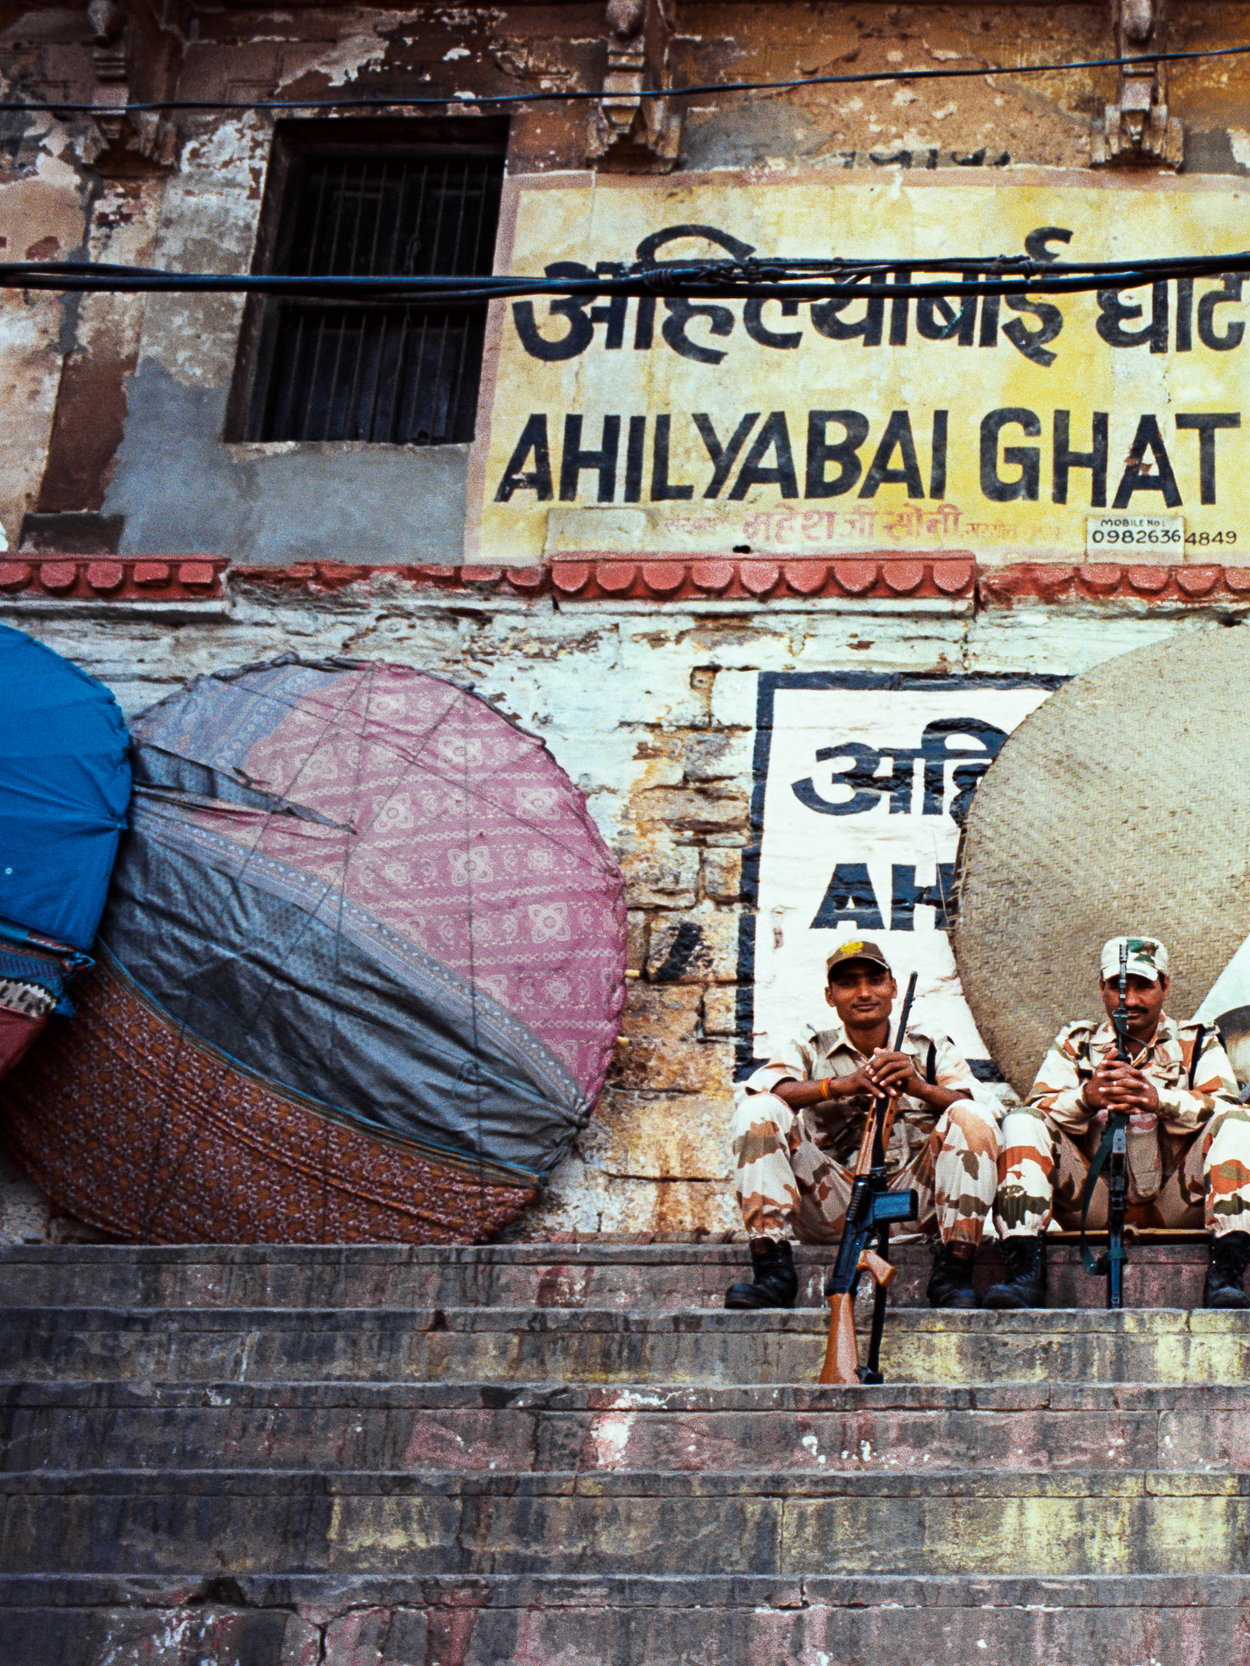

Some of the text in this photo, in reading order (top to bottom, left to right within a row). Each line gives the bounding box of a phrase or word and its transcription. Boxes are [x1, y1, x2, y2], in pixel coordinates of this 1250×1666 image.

[1095, 270, 1249, 354] घाट
[493, 406, 1242, 510] AHILYABAI GHAT
[1100, 518, 1144, 528] MOBILE
[808, 862, 958, 931] AH
